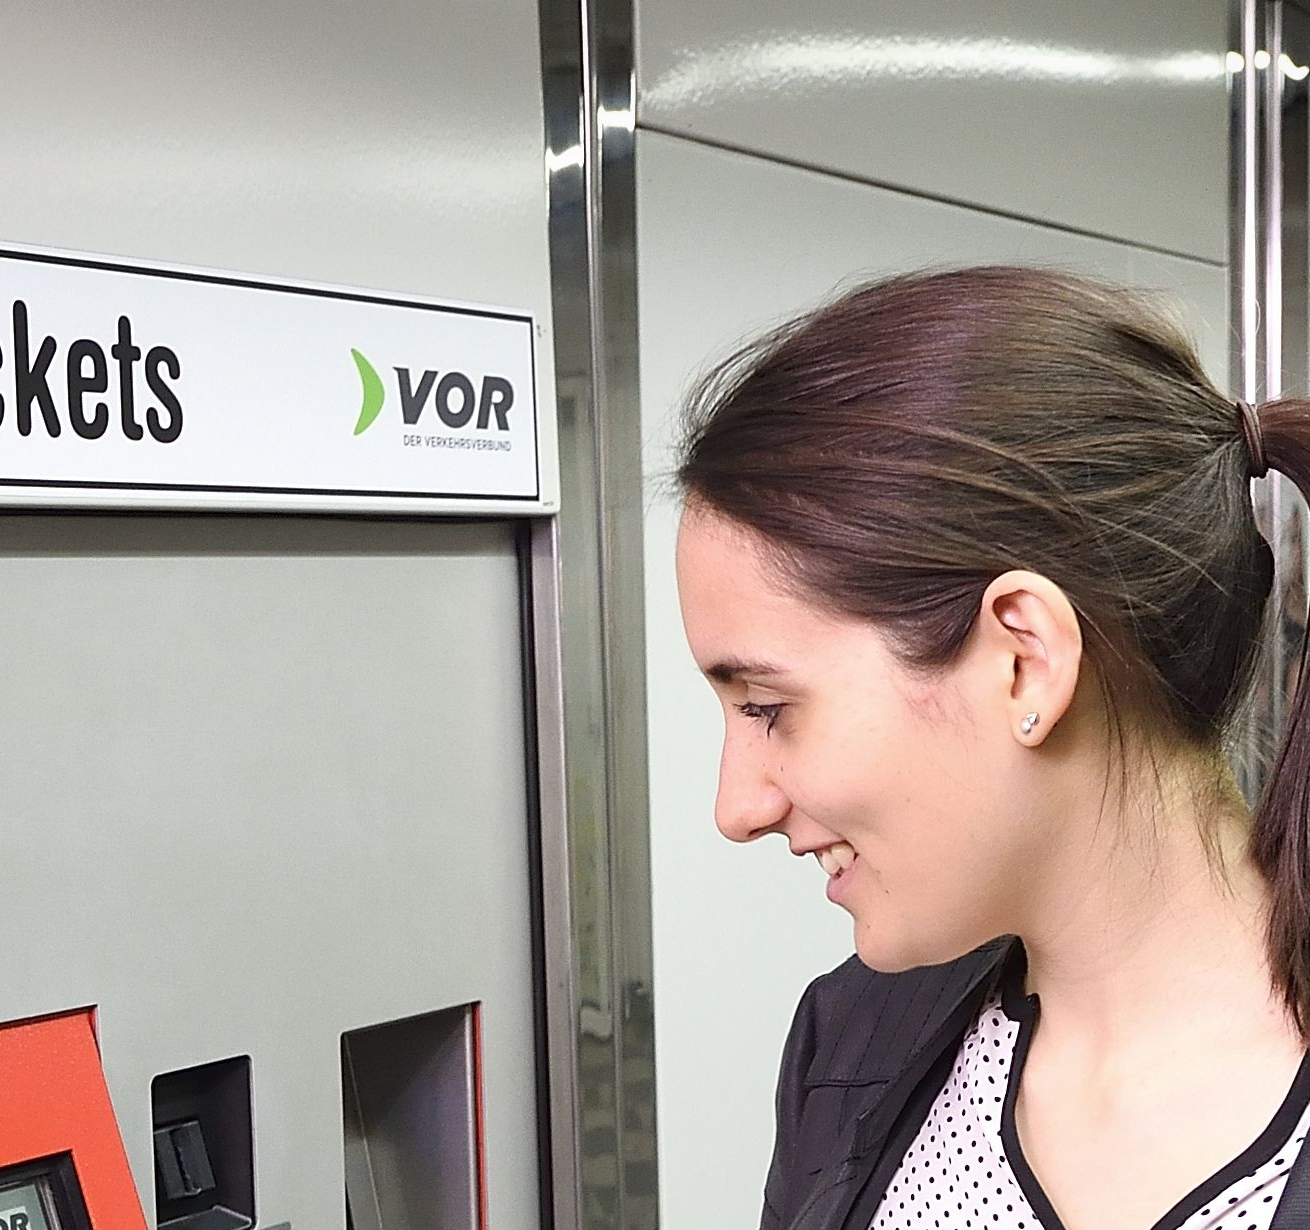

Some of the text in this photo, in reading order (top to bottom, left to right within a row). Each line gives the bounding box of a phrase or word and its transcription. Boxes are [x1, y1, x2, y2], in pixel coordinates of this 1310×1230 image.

[393, 366, 515, 431] VOR
[403, 434, 512, 452] DER VERKEHRSVERBUND
